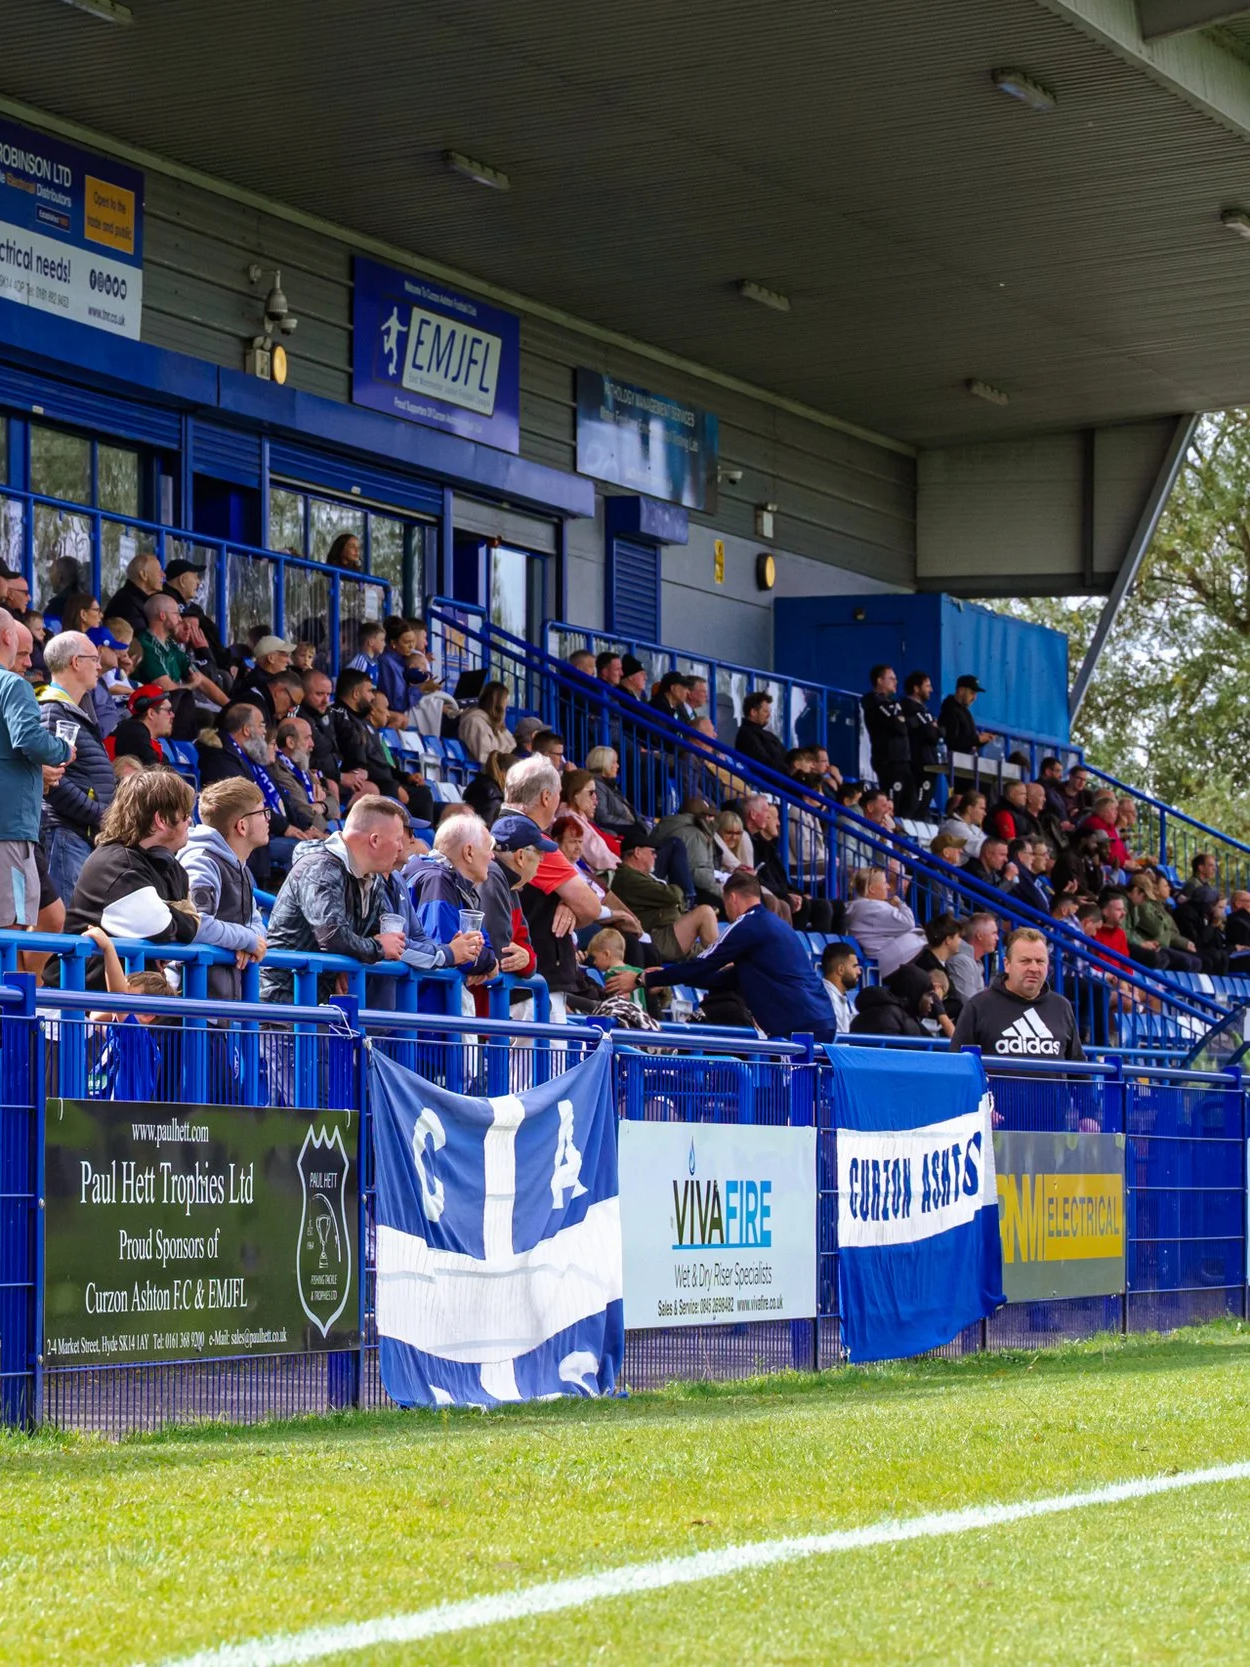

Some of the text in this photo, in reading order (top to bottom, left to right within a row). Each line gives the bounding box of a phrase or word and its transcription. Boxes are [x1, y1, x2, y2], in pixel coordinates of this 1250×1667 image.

[53, 163, 72, 188] LTD
[36, 184, 72, 208] Distributors
[93, 191, 109, 208] Open
[36, 253, 71, 284] needs!
[411, 318, 490, 393] EMJFL
[995, 1037, 1060, 1055] adidas
[132, 1117, 209, 1148] www.paulhett.com
[80, 1159, 254, 1216] Paul Hett Trophies Ltd
[310, 1172, 338, 1188] PAUL HETT
[849, 1156, 912, 1223] CURZON
[672, 1179, 772, 1248] VIVAFIRE
[1048, 1196, 1120, 1238] ELECTRICAL
[119, 1227, 220, 1268] Proud Sponsors of
[674, 1261, 773, 1292] Wet & Dry Riser Specialists
[85, 1278, 248, 1315] Curzon Ashton F.C & EMJFL
[658, 1300, 673, 1317] Sales
[679, 1298, 699, 1315] Service:
[700, 1298, 711, 1314] 0845
[737, 1294, 783, 1312] www.vivafire.co.uk
[47, 1339, 57, 1355] 2-4
[58, 1337, 80, 1355] Market
[101, 1335, 118, 1356] Hyde
[118, 1334, 136, 1352] SK14
[137, 1333, 150, 1351] 1AY
[152, 1333, 164, 1350] Tel:
[165, 1332, 178, 1349] 0161
[231, 1326, 287, 1349] sales@paulhett.co.uk
